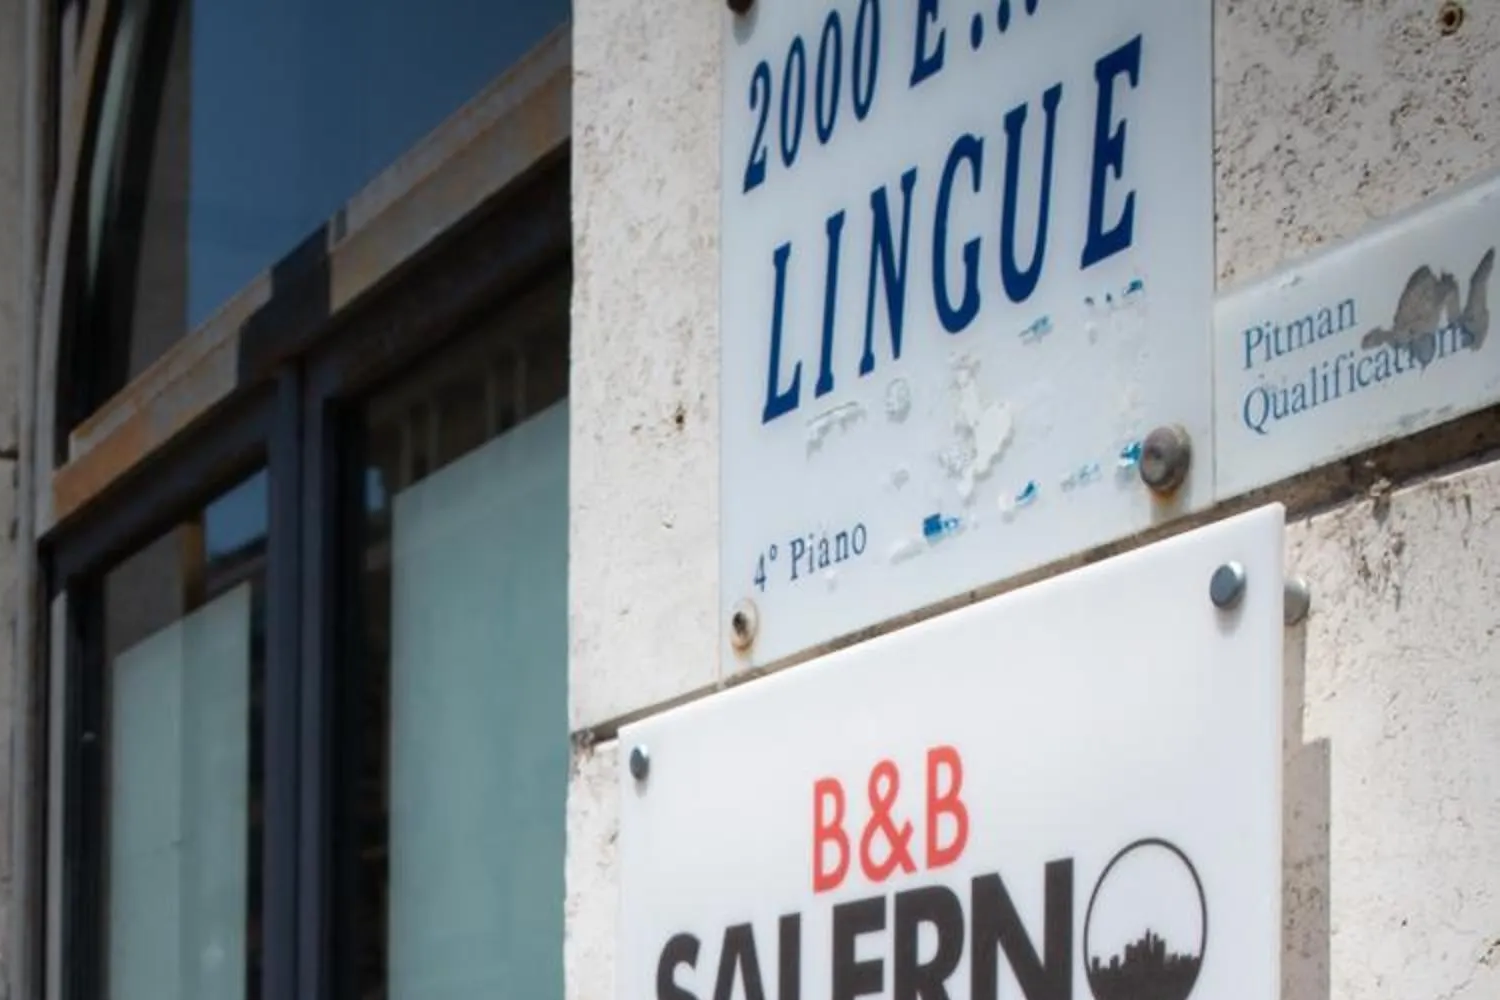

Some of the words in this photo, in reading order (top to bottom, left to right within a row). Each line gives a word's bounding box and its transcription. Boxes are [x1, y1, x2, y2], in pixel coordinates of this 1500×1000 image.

[742, 0, 881, 194] 2000
[761, 33, 1143, 425] LINGUE
[1242, 316, 1477, 436] Qualifications
[1243, 297, 1358, 371] Pitman
[789, 521, 868, 581] Piano
[811, 744, 970, 894] B&B
